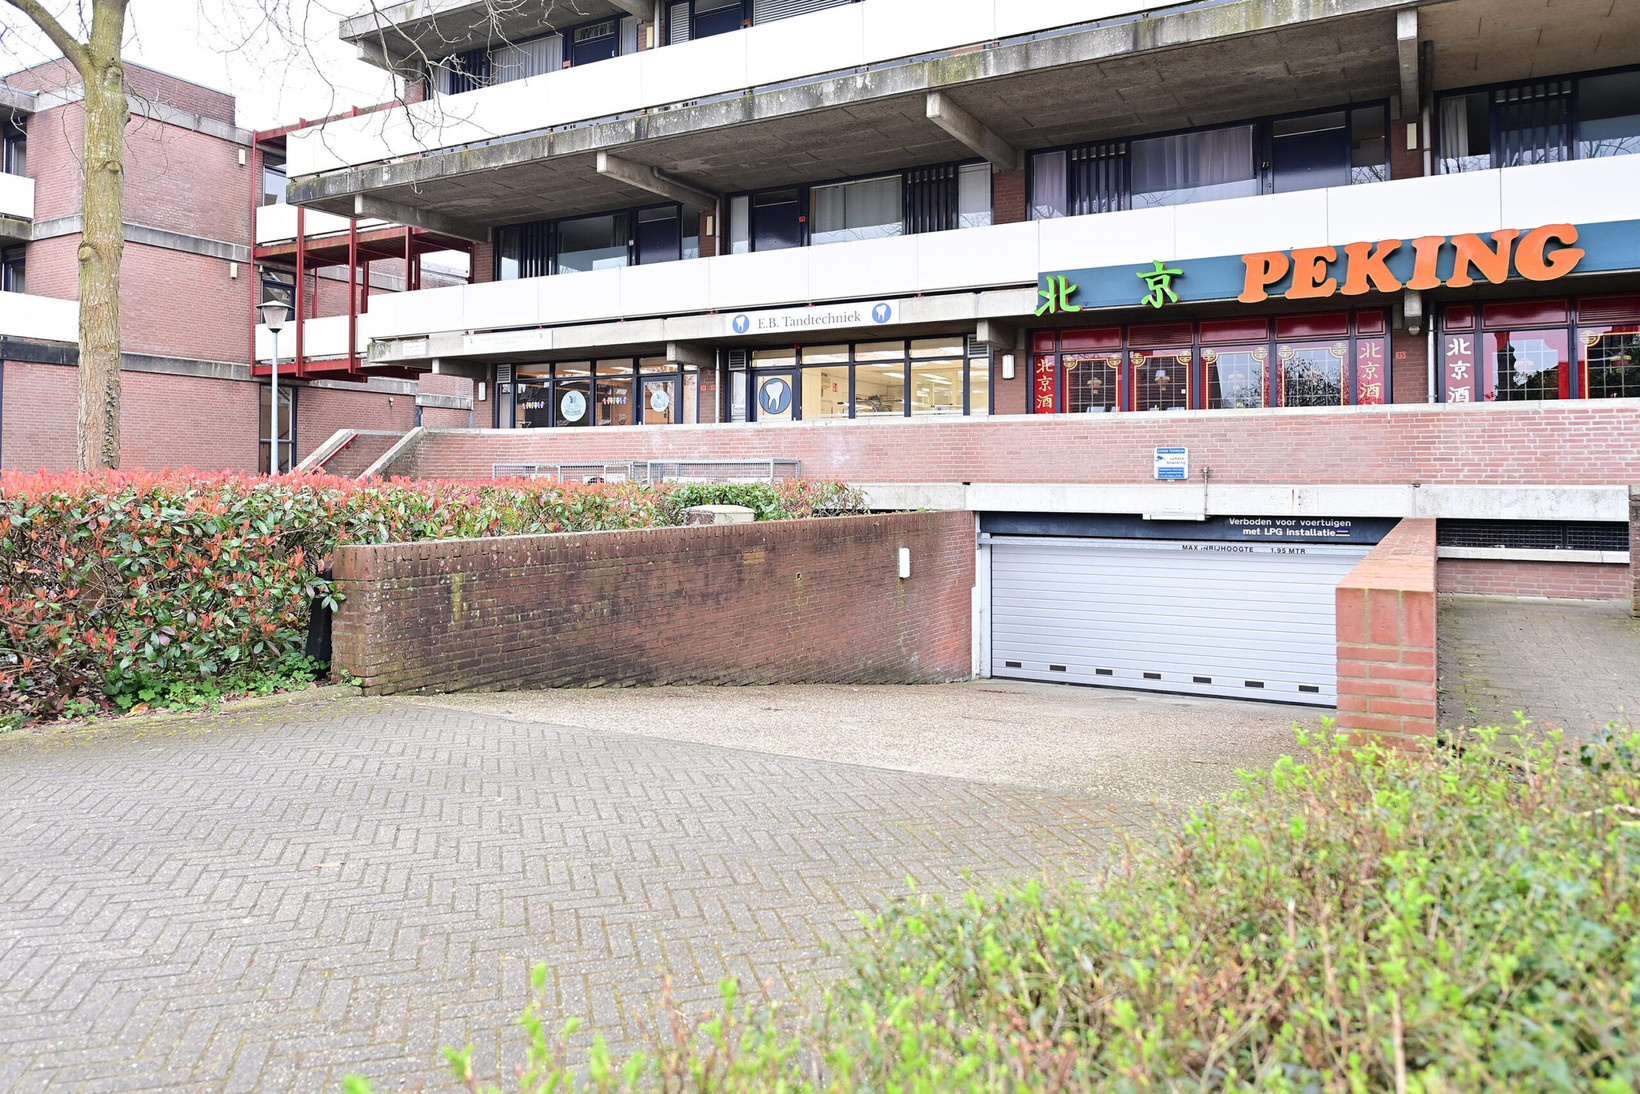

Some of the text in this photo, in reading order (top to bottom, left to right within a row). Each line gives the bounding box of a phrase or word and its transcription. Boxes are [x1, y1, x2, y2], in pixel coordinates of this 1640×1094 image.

[1034, 261, 1184, 316] 北京
[1237, 223, 1586, 303] PEKING
[758, 310, 861, 329] E.B. Tandtechniek
[1036, 358, 1054, 414] 北京酒
[1359, 342, 1382, 405] 北京酒
[1229, 517, 1272, 526] Verboden
[1300, 518, 1351, 528] voertuigen
[1242, 528, 1336, 537] met LPG installatie
